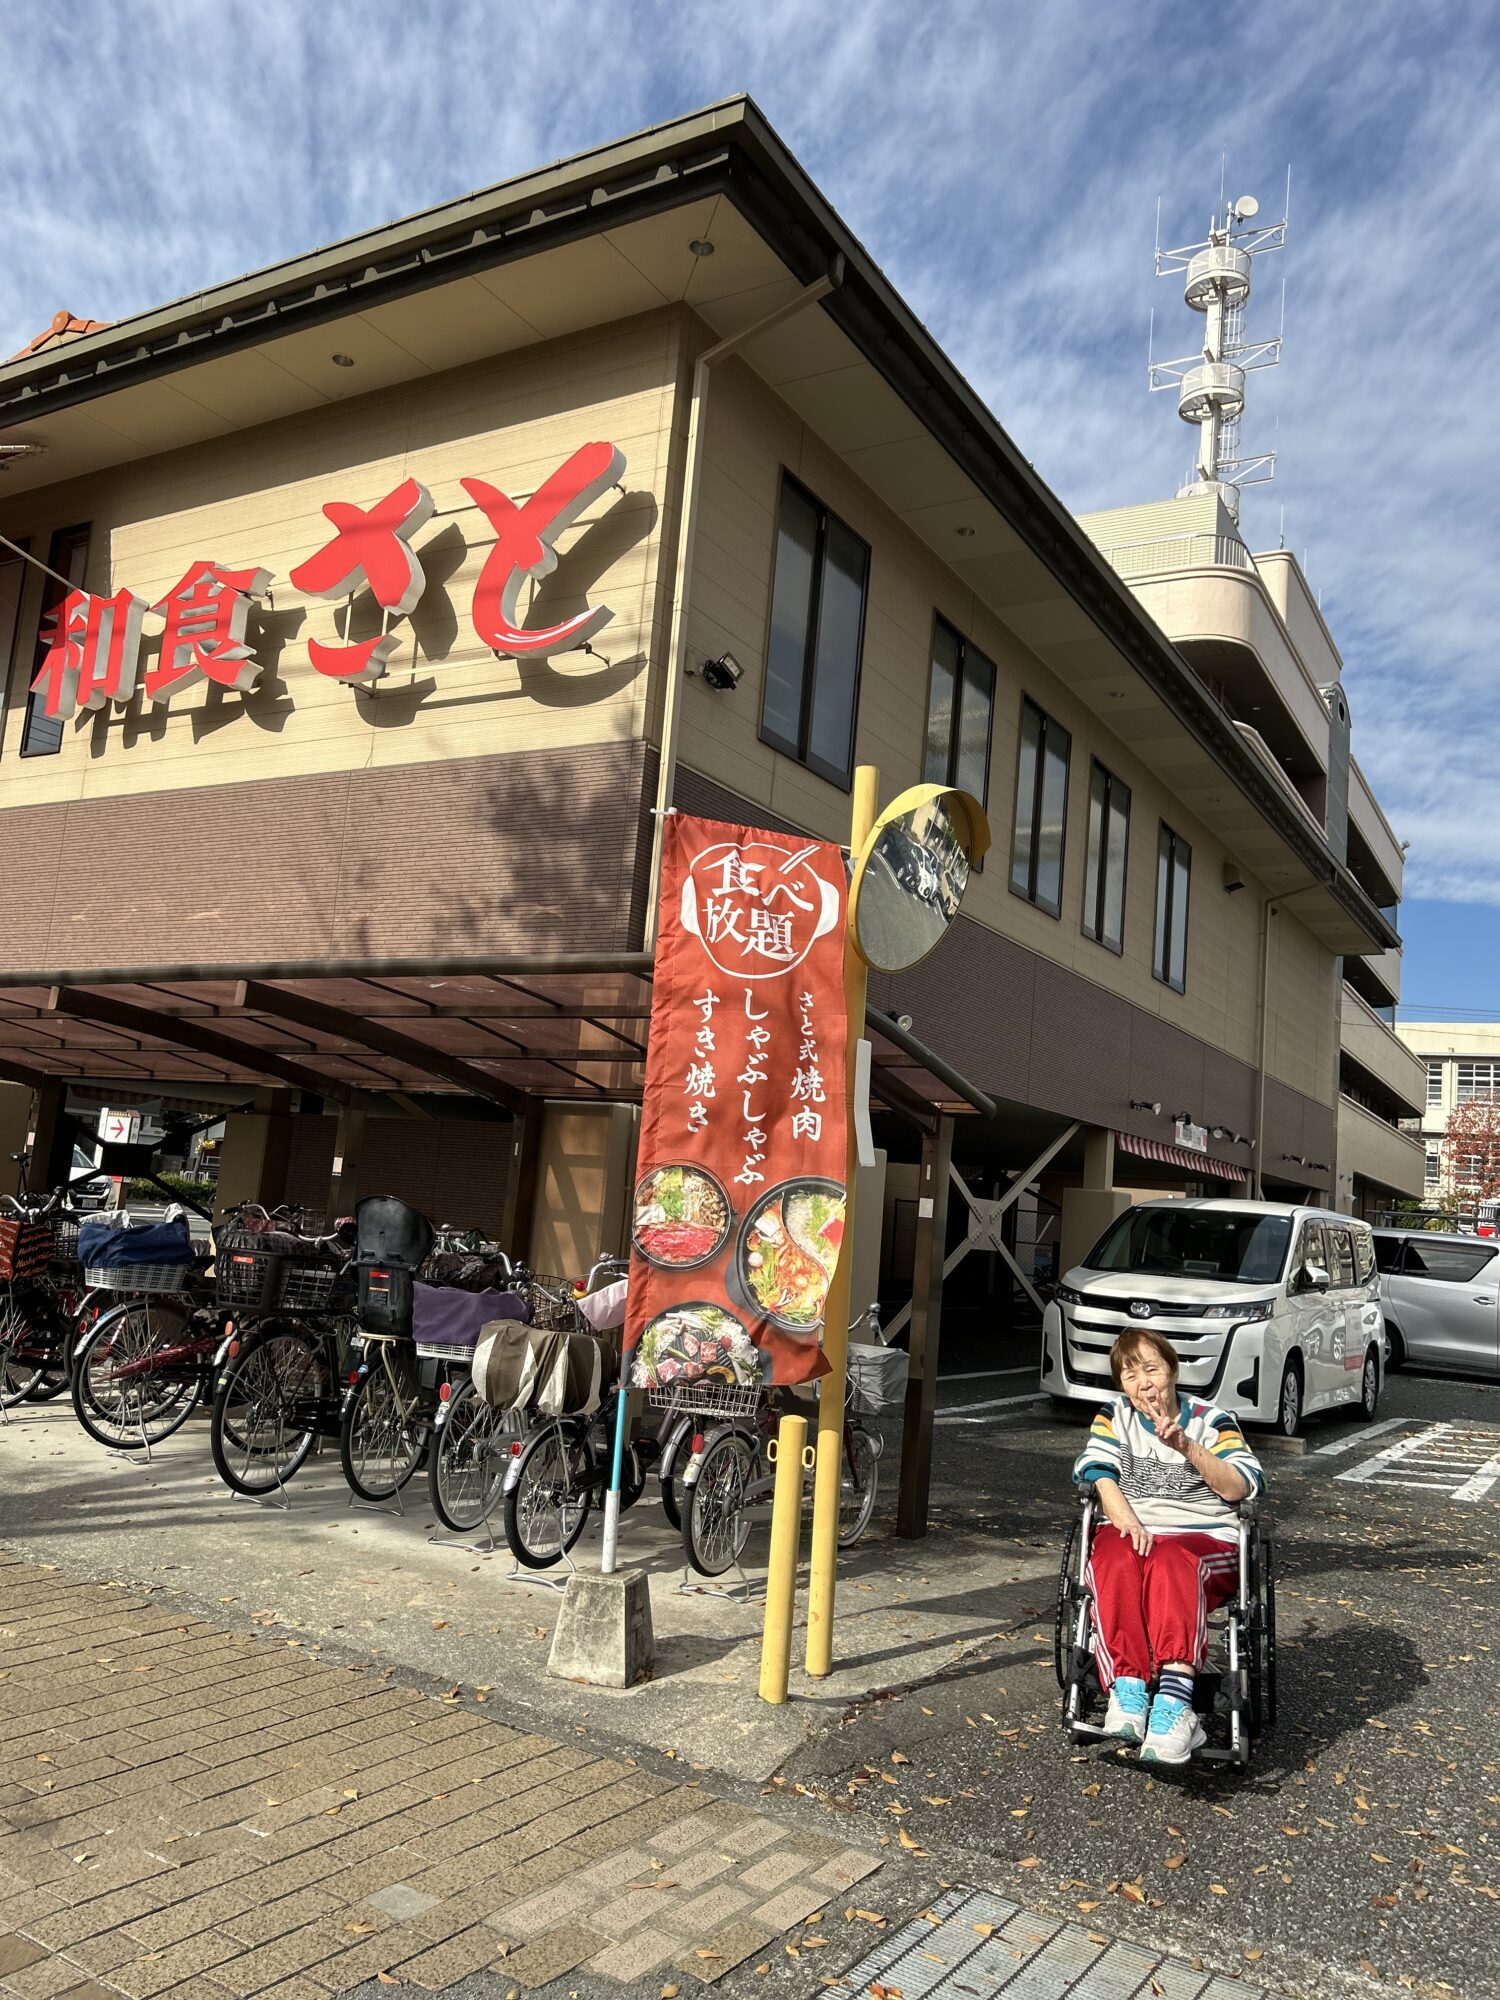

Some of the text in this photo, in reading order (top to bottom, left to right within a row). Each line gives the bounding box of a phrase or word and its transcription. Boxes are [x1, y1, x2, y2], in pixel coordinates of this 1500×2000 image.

[31, 441, 627, 720] 和食さと
[702, 898, 800, 963] 放題
[703, 849, 815, 912] 食べ
[683, 988, 720, 1133] すき焼き
[733, 988, 772, 1185] しゃぶしゃぶ
[790, 991, 826, 1142] さと式焼肉
